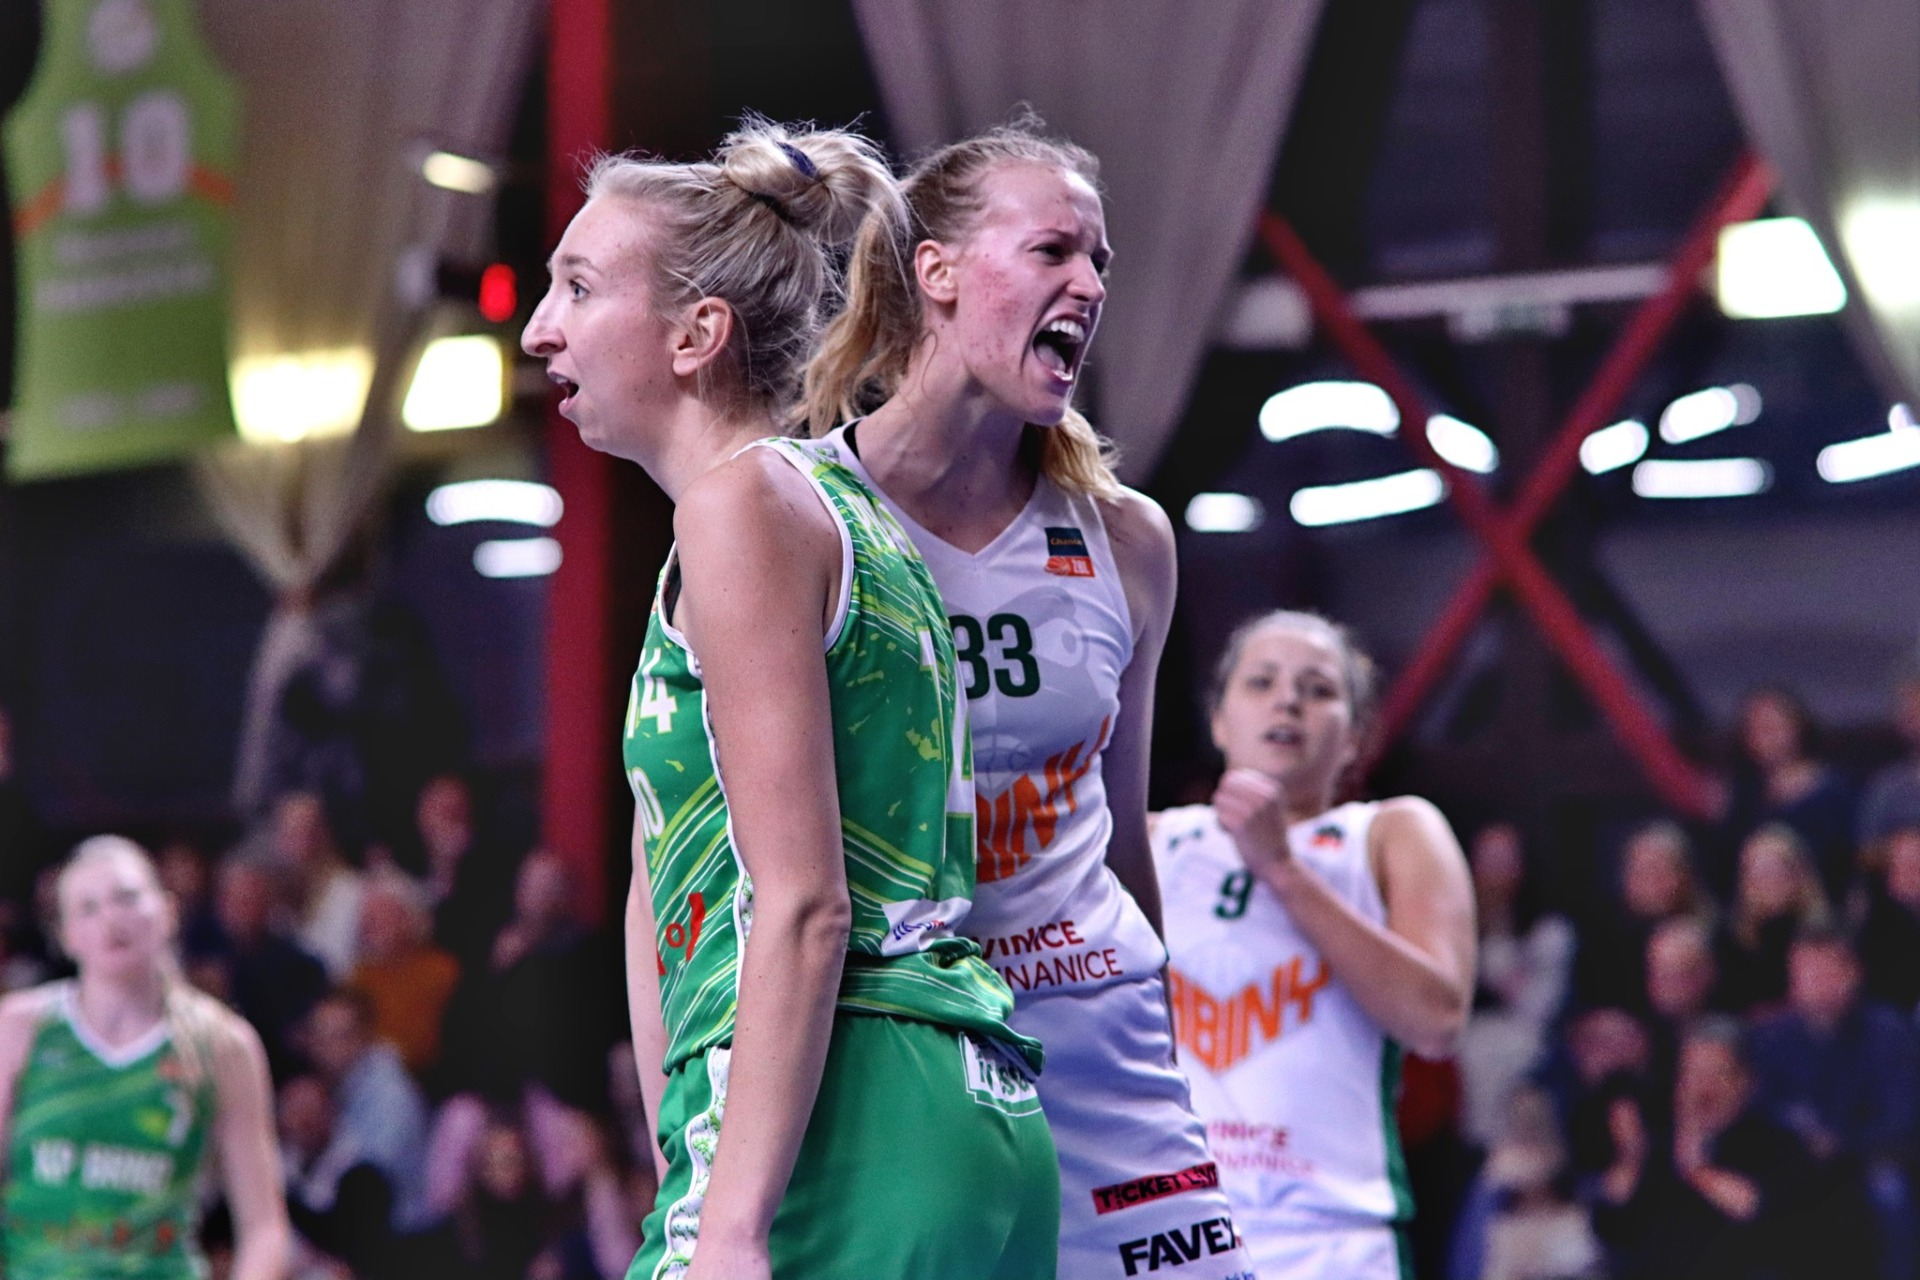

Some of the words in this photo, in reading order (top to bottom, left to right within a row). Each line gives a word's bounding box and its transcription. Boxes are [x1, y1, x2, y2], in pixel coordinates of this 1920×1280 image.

[61, 93, 191, 218] 10
[948, 613, 1041, 700] 33
[1214, 869, 1254, 920] 9
[994, 948, 1124, 991] NANICE
[1097, 1174, 1183, 1211] TICKET
